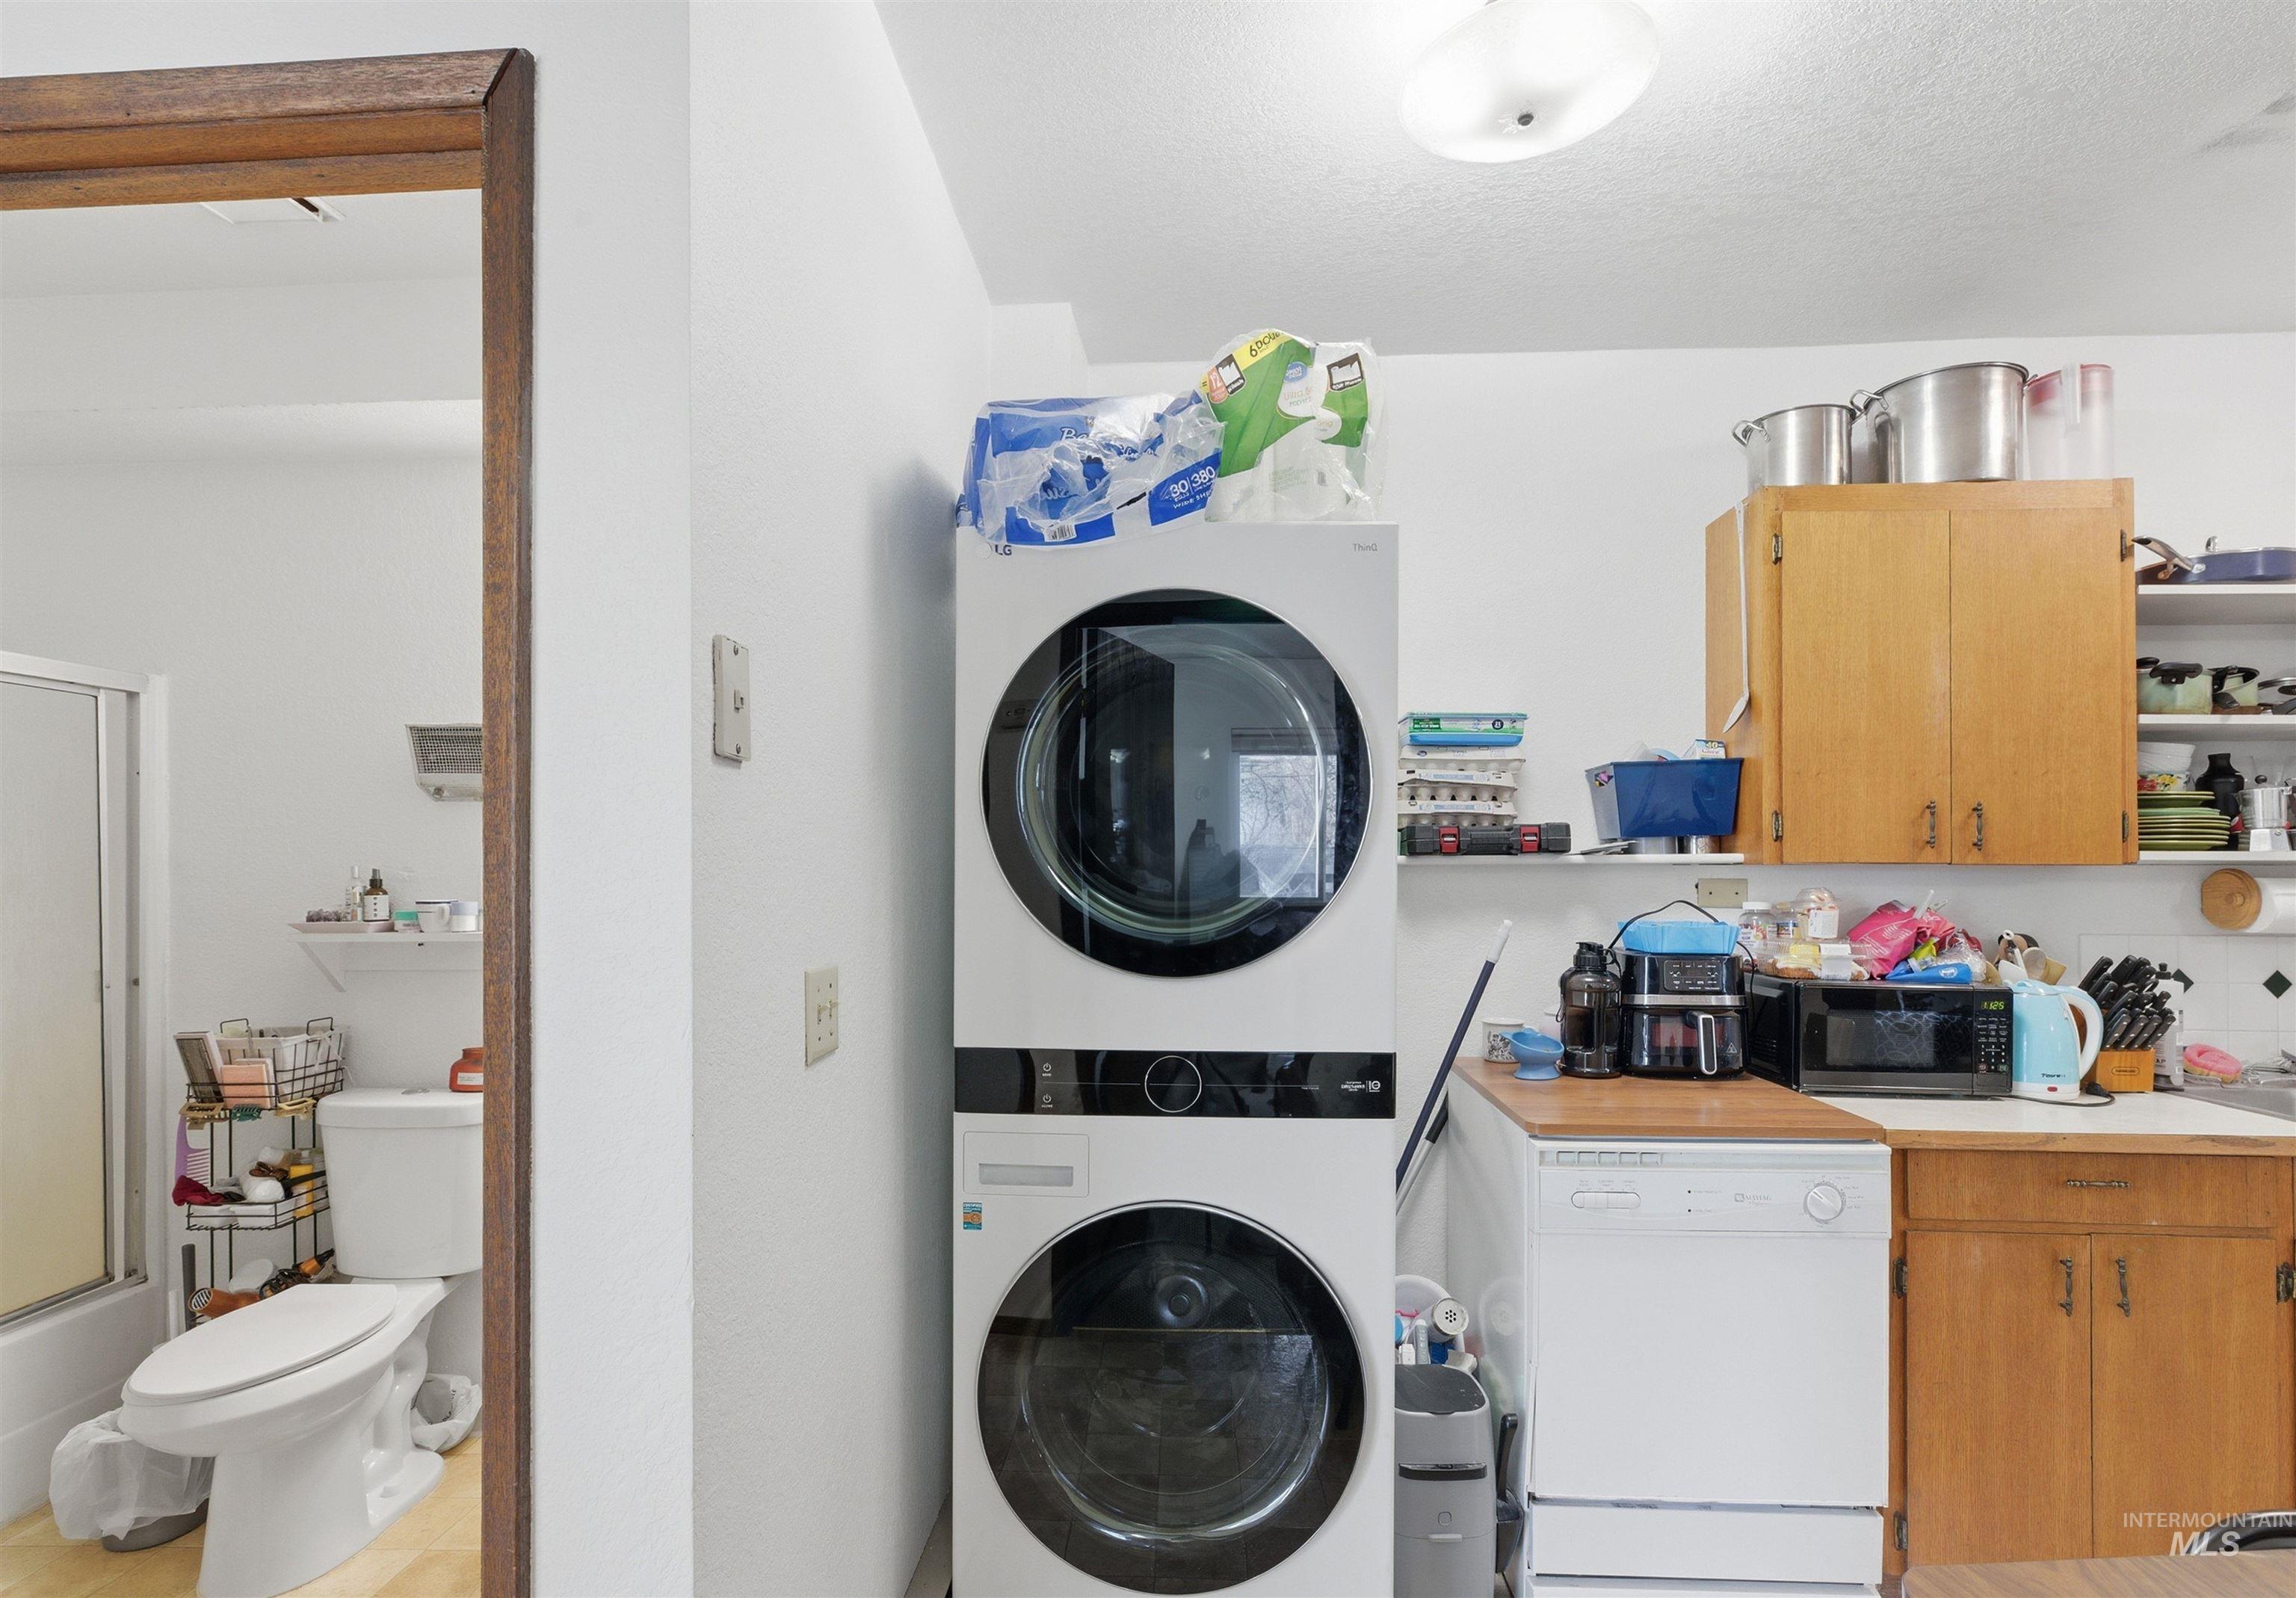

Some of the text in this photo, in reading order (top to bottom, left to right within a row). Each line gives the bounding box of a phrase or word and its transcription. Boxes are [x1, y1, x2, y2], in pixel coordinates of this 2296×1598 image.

[1250, 345, 1258, 357] 6
[1170, 480, 1189, 497] 30
[1191, 466, 1215, 487] 380
[995, 544, 1012, 556] LG
[1353, 543, 1378, 552] ThinQ
